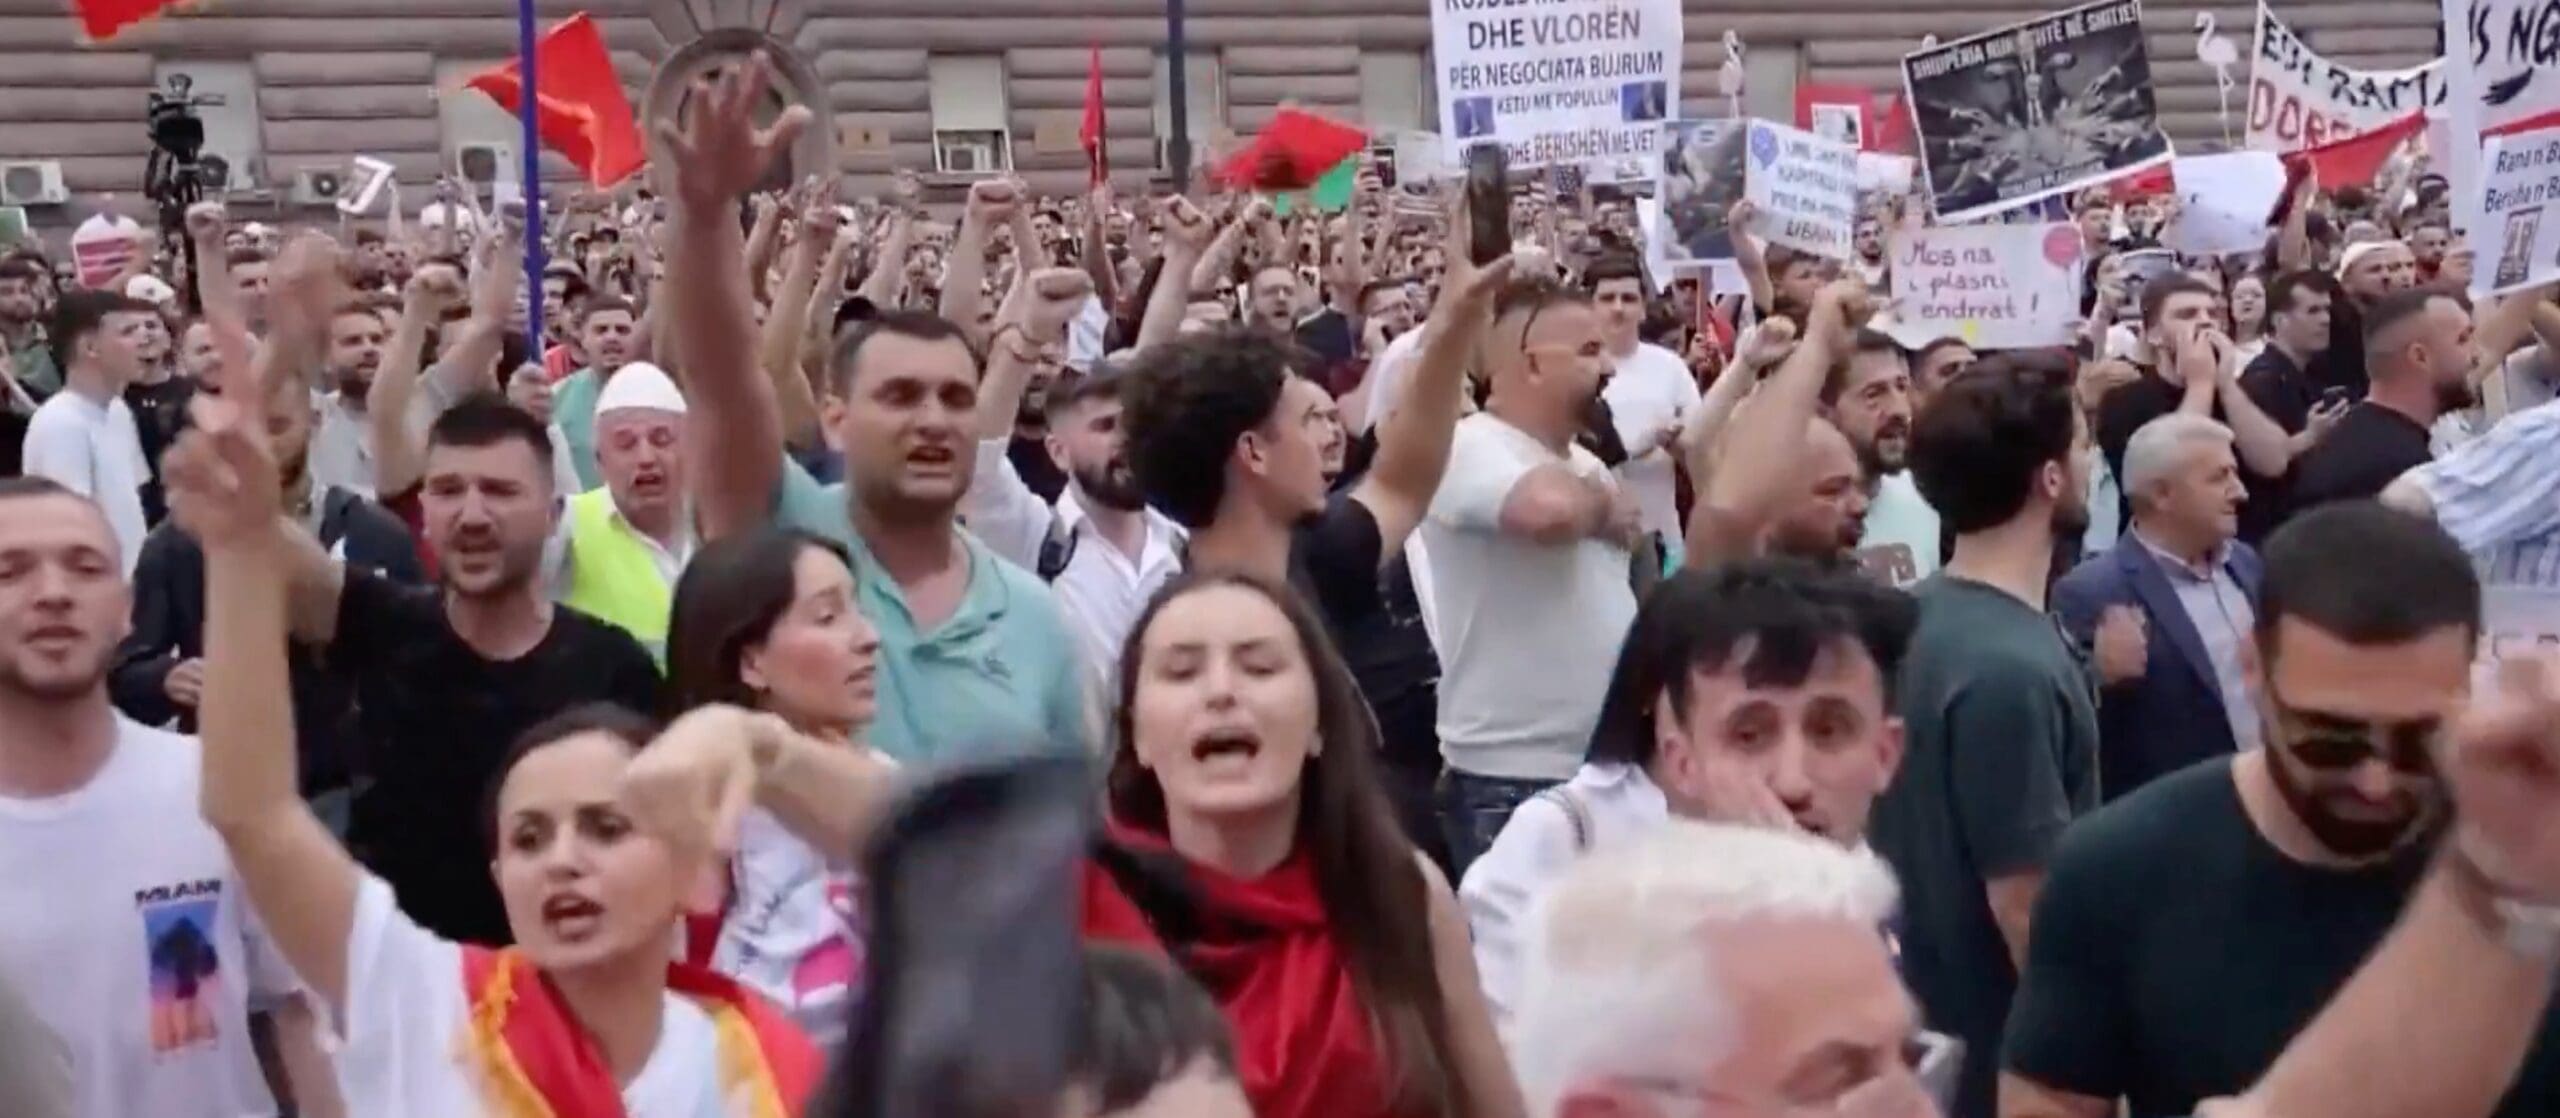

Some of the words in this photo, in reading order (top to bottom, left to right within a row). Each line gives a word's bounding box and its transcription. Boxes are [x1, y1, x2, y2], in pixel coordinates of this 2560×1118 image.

[1468, 18, 1525, 49] DHE
[1531, 6, 1641, 46] VLORËN
[1450, 61, 1481, 89] PËR
[1486, 57, 1586, 87] NEGOCIATA
[1590, 52, 1664, 79] BUJRUM
[1902, 240, 1957, 267] Mos
[1963, 247, 1995, 264] na
